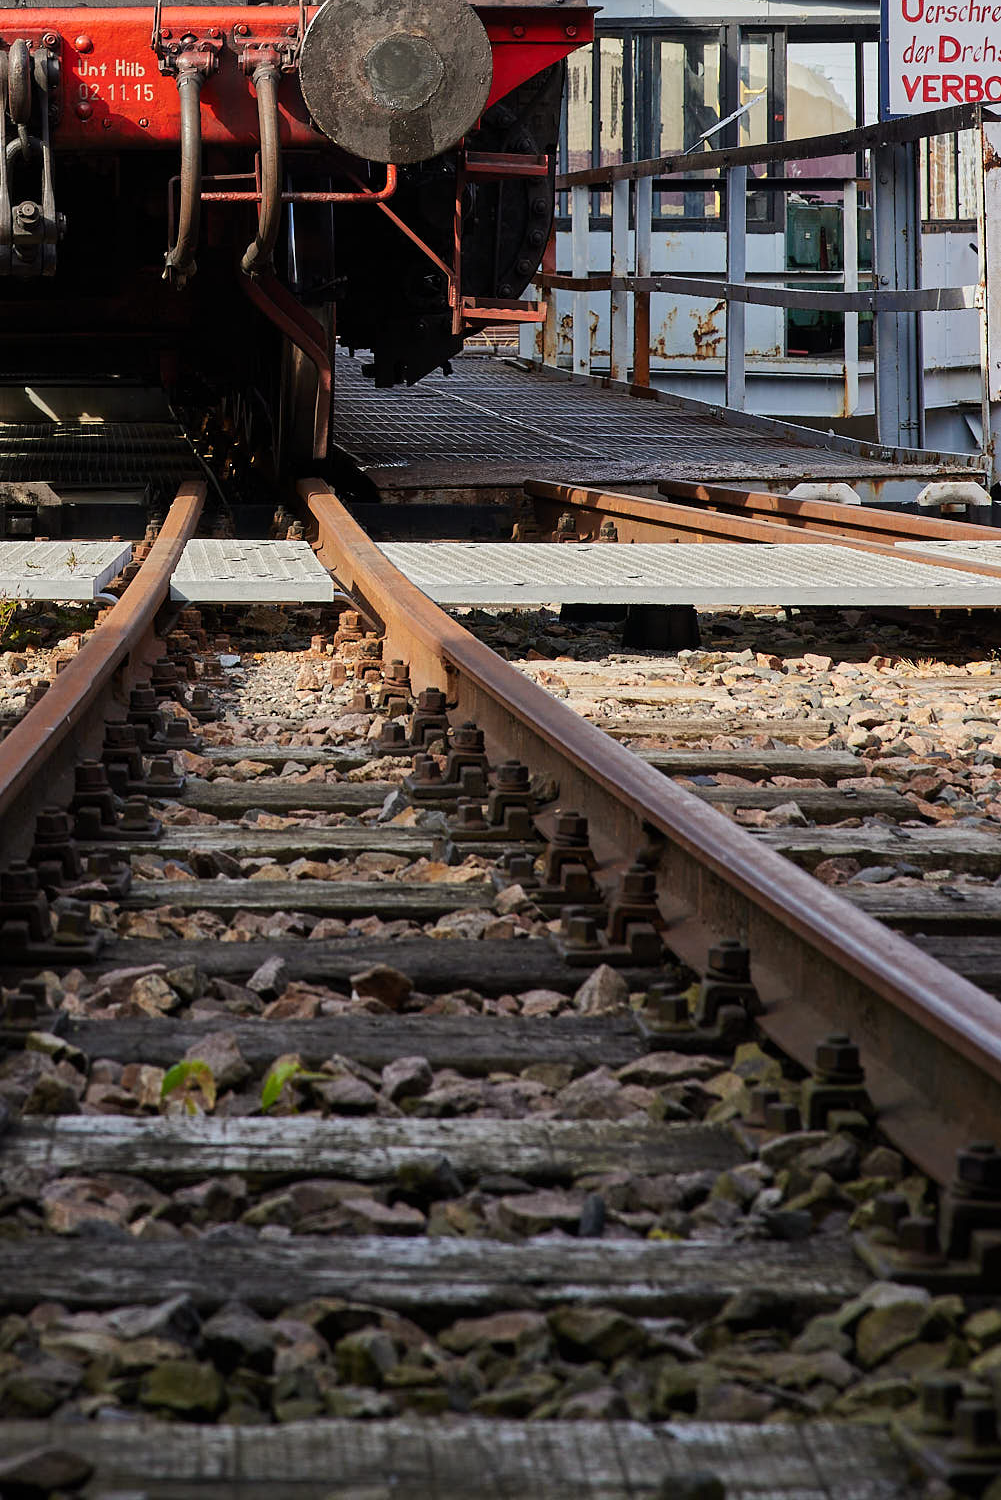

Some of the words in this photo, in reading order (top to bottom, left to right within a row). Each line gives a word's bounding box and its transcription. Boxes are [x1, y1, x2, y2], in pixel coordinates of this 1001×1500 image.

[902, 35, 935, 64] der
[78, 59, 107, 77] Unt
[115, 59, 146, 77] Hilb
[79, 83, 154, 102] 02.11.15
[901, 74, 1001, 103] VERBO
